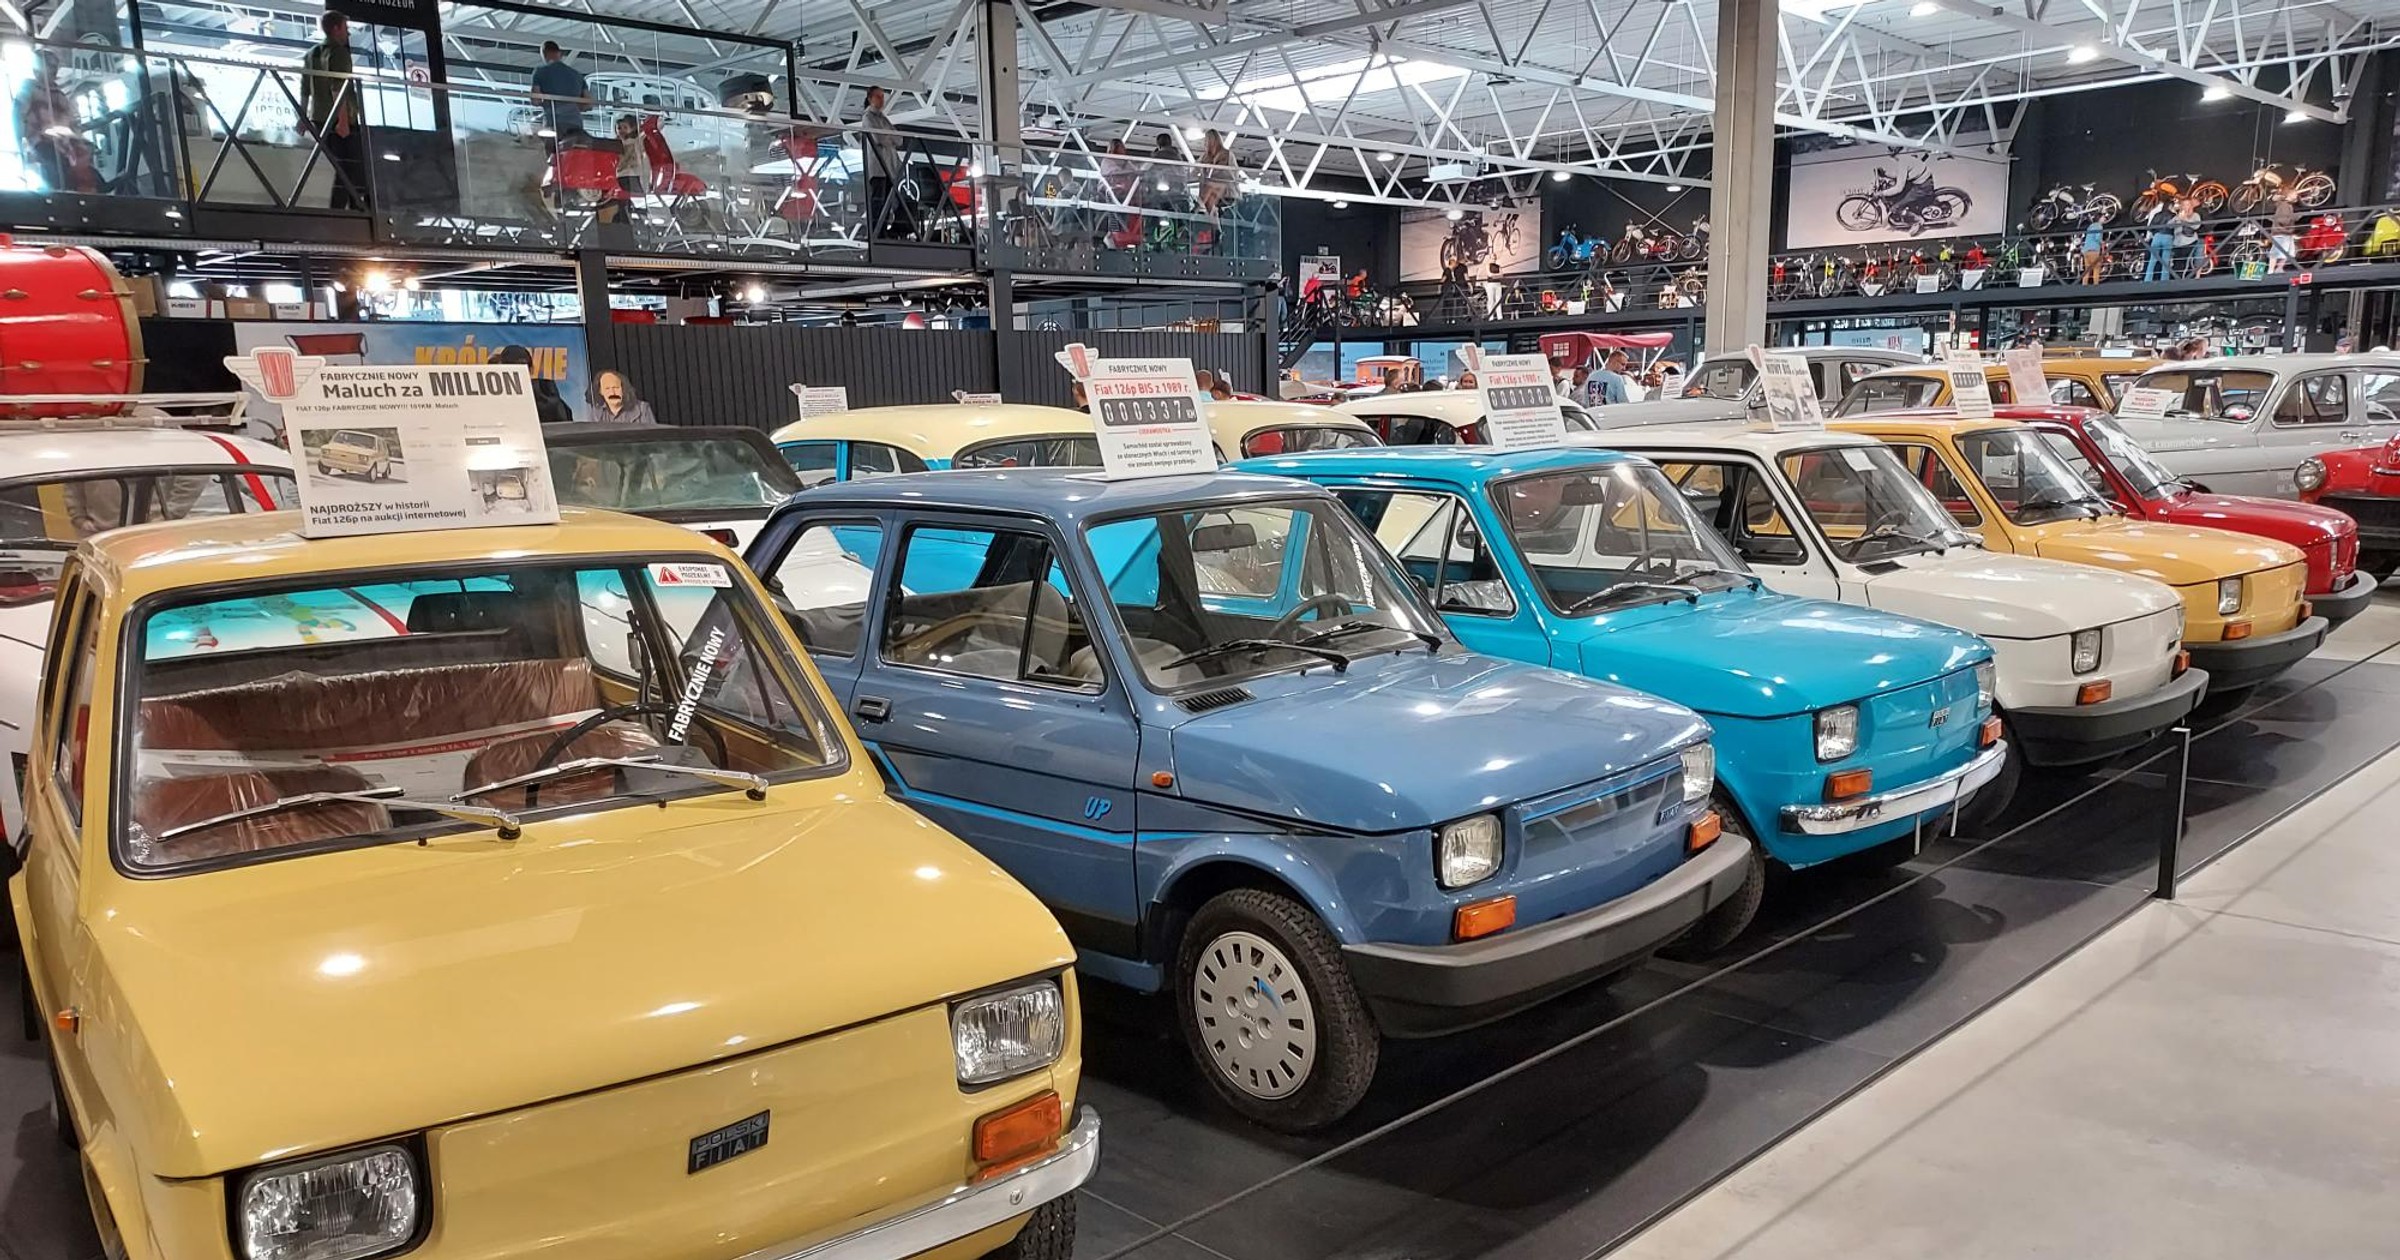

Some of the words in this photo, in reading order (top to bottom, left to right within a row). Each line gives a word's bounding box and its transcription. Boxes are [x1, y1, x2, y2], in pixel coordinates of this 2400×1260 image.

[320, 373, 386, 381] FABRYCZNIE
[388, 372, 419, 380] NOWY
[1108, 365, 1148, 373] FABRYCZNIE
[323, 383, 397, 398] Maluch
[401, 384, 424, 397] za
[429, 371, 523, 396] MILION
[1094, 383, 1113, 395] Fiat
[1114, 382, 1137, 397] 126p
[1137, 381, 1154, 393] BIS
[1162, 381, 1182, 393] 1989
[1104, 400, 1181, 422] 000337
[310, 501, 382, 515] NAJDROŻSZY
[395, 500, 430, 510] historii
[312, 516, 332, 525] Fiat
[334, 514, 359, 525] 126p
[360, 514, 373, 522] na
[374, 511, 404, 522] aukcji
[405, 509, 467, 520] internetowej
[668, 662, 712, 742] FABRYCZNIE
[700, 625, 726, 665] NOWY
[1084, 796, 1112, 820] UP
[692, 1114, 766, 1152] POLSKI
[695, 1130, 764, 1169] FIAT
